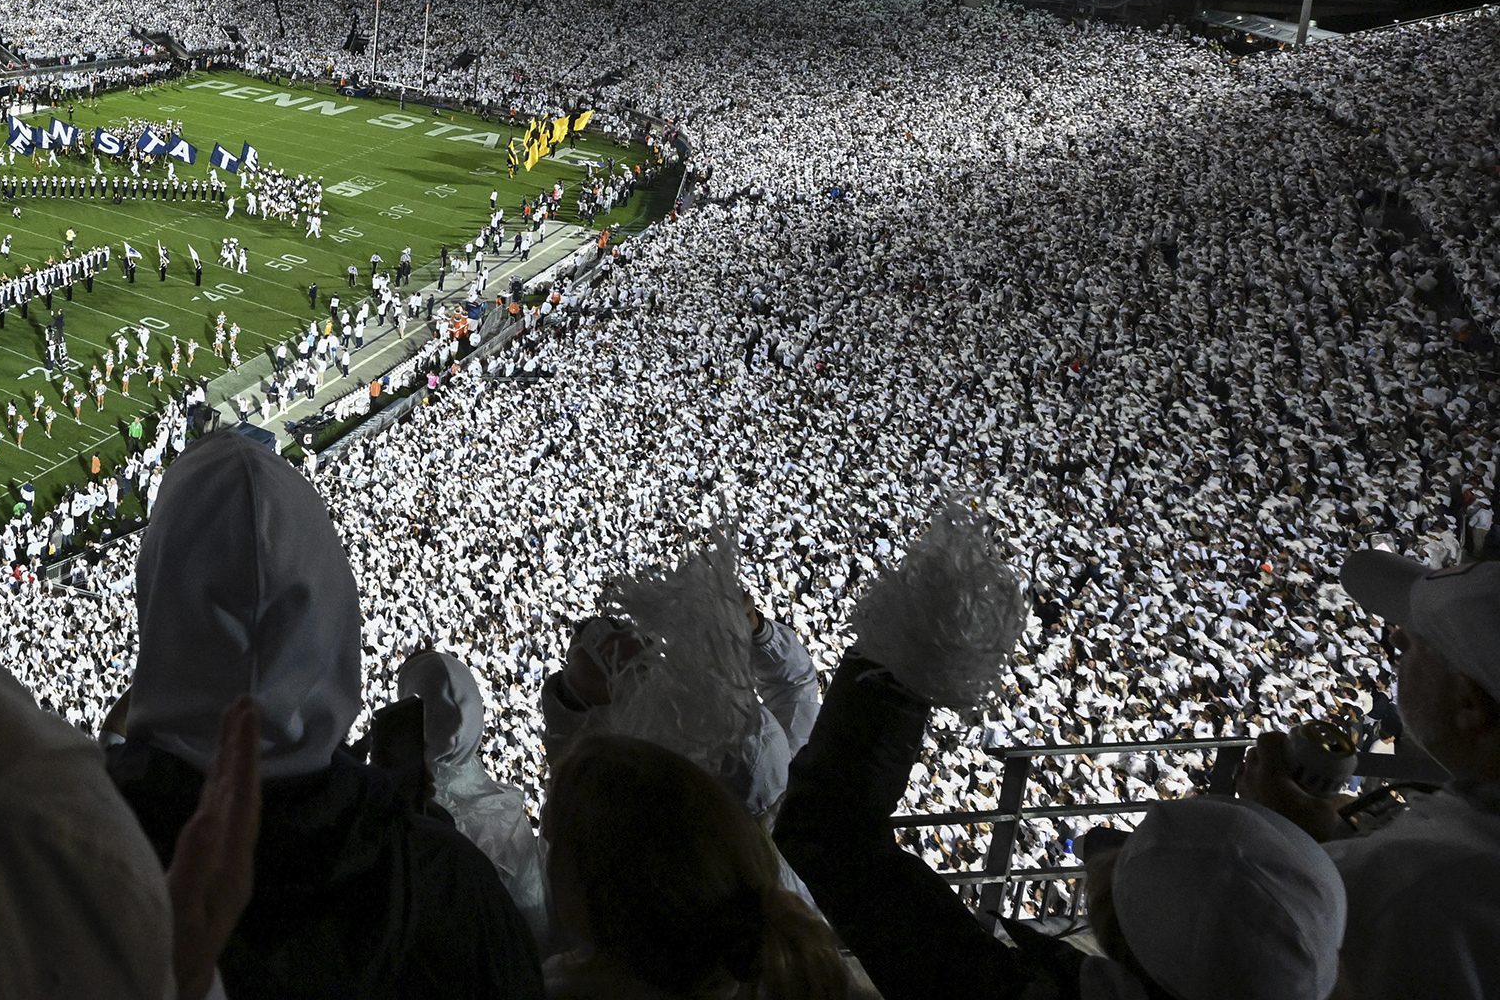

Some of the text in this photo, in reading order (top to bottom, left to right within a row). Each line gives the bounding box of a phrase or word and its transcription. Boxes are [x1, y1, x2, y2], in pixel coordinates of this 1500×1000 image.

[186, 80, 359, 117] PENN
[424, 184, 458, 199] 20
[378, 204, 414, 220] 30
[328, 226, 364, 244] 40
[264, 253, 308, 272] 50
[202, 282, 245, 302] 40
